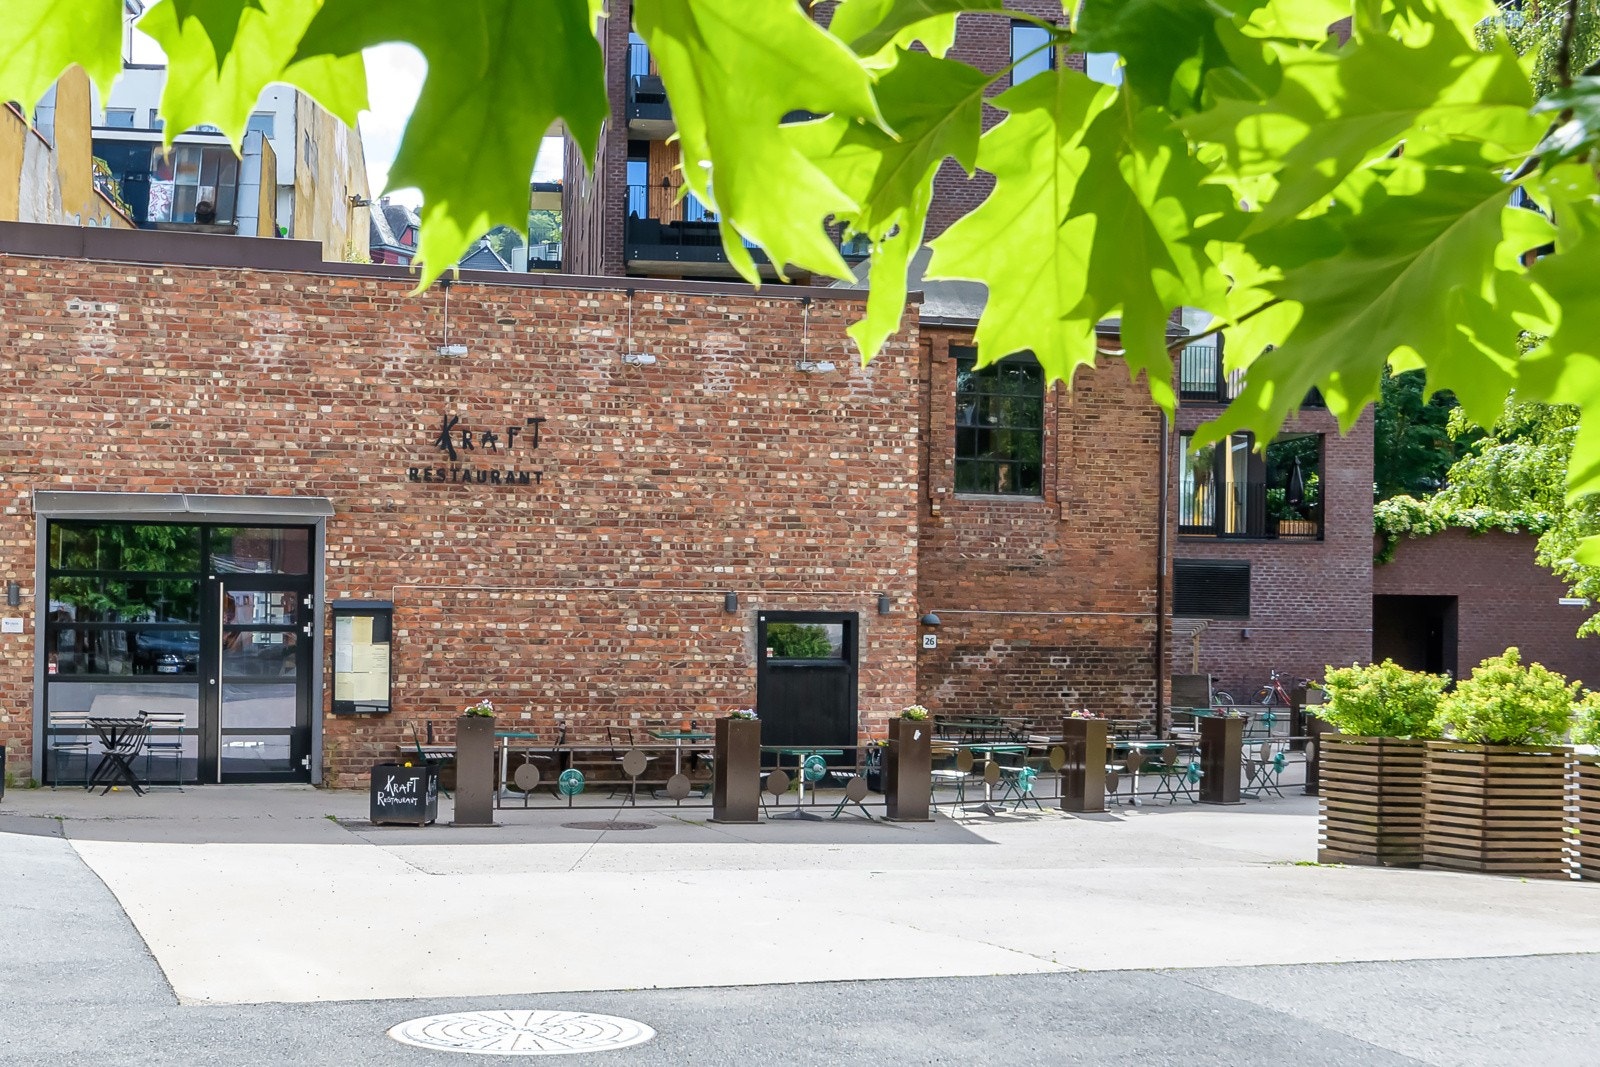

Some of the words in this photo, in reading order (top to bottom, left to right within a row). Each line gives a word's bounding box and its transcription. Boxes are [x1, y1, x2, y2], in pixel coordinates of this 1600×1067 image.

[435, 414, 547, 461] KRAFT
[409, 467, 543, 485] RESTAURANT
[925, 637, 935, 645] 26
[384, 775, 419, 796] KRAFT
[377, 791, 419, 806] RESTAURANT
